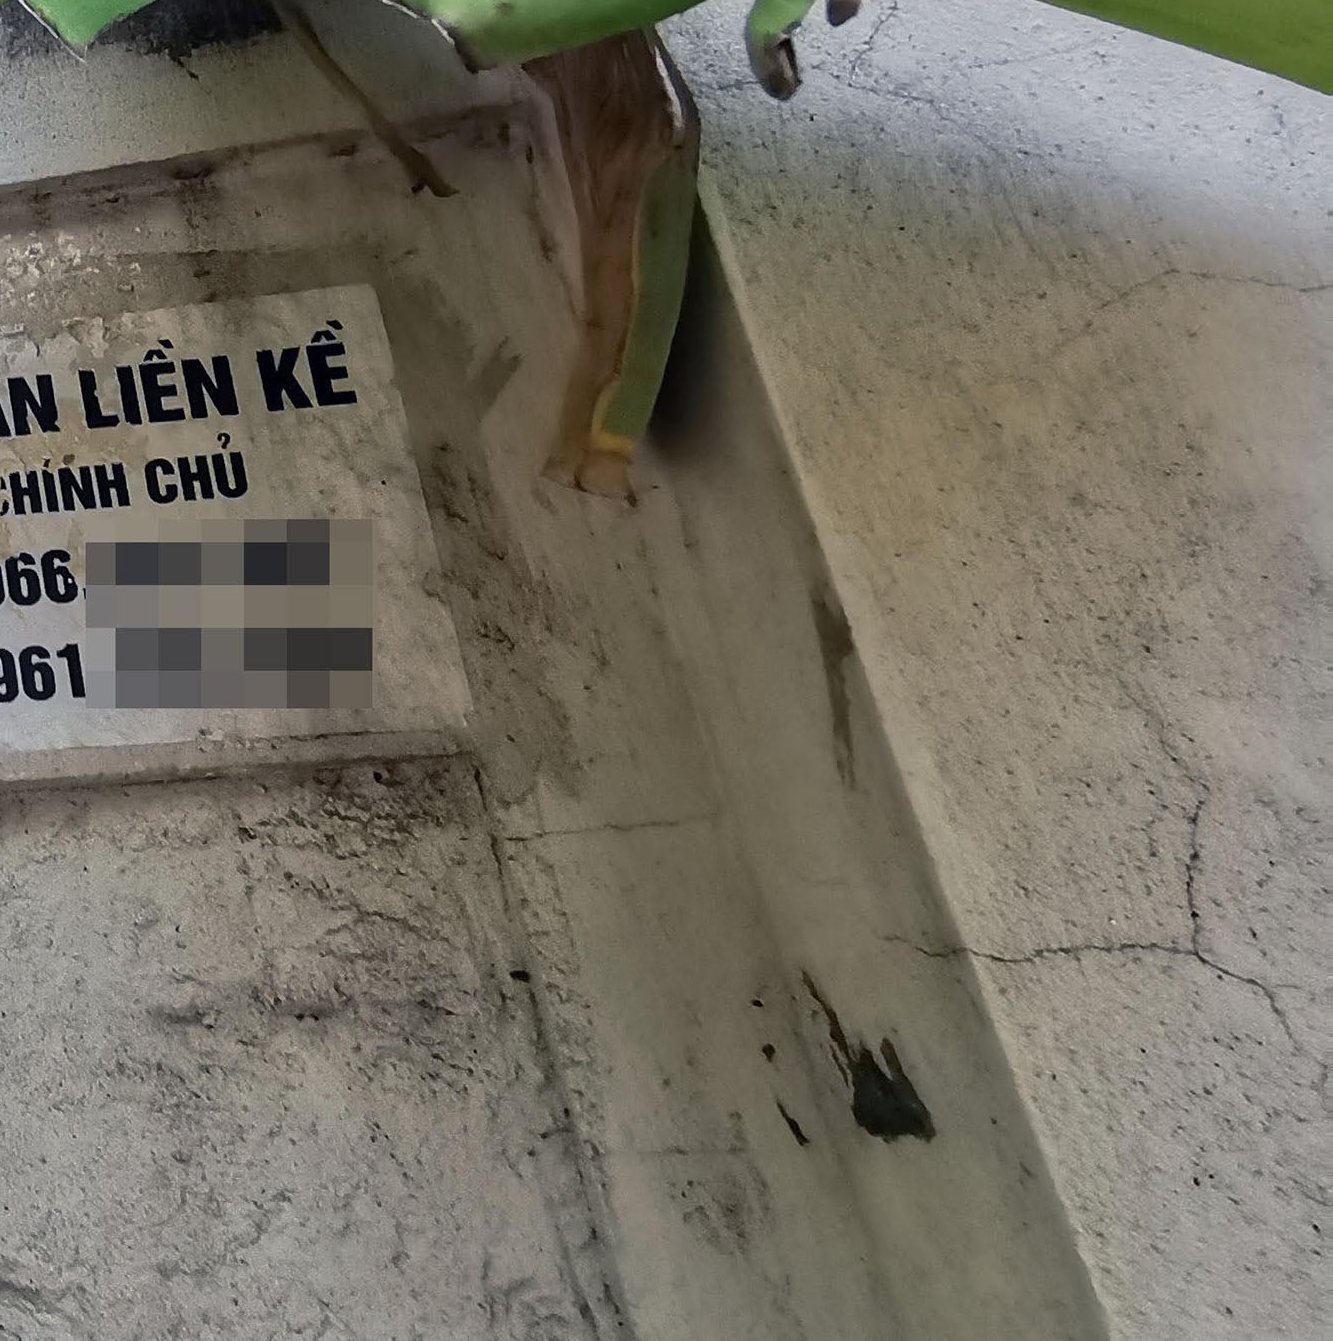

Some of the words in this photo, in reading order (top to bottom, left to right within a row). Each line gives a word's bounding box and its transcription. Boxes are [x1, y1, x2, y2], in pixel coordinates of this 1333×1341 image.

[78, 339, 239, 429] LIỀN
[256, 319, 358, 412] KỀ
[144, 432, 248, 504] CHỦ
